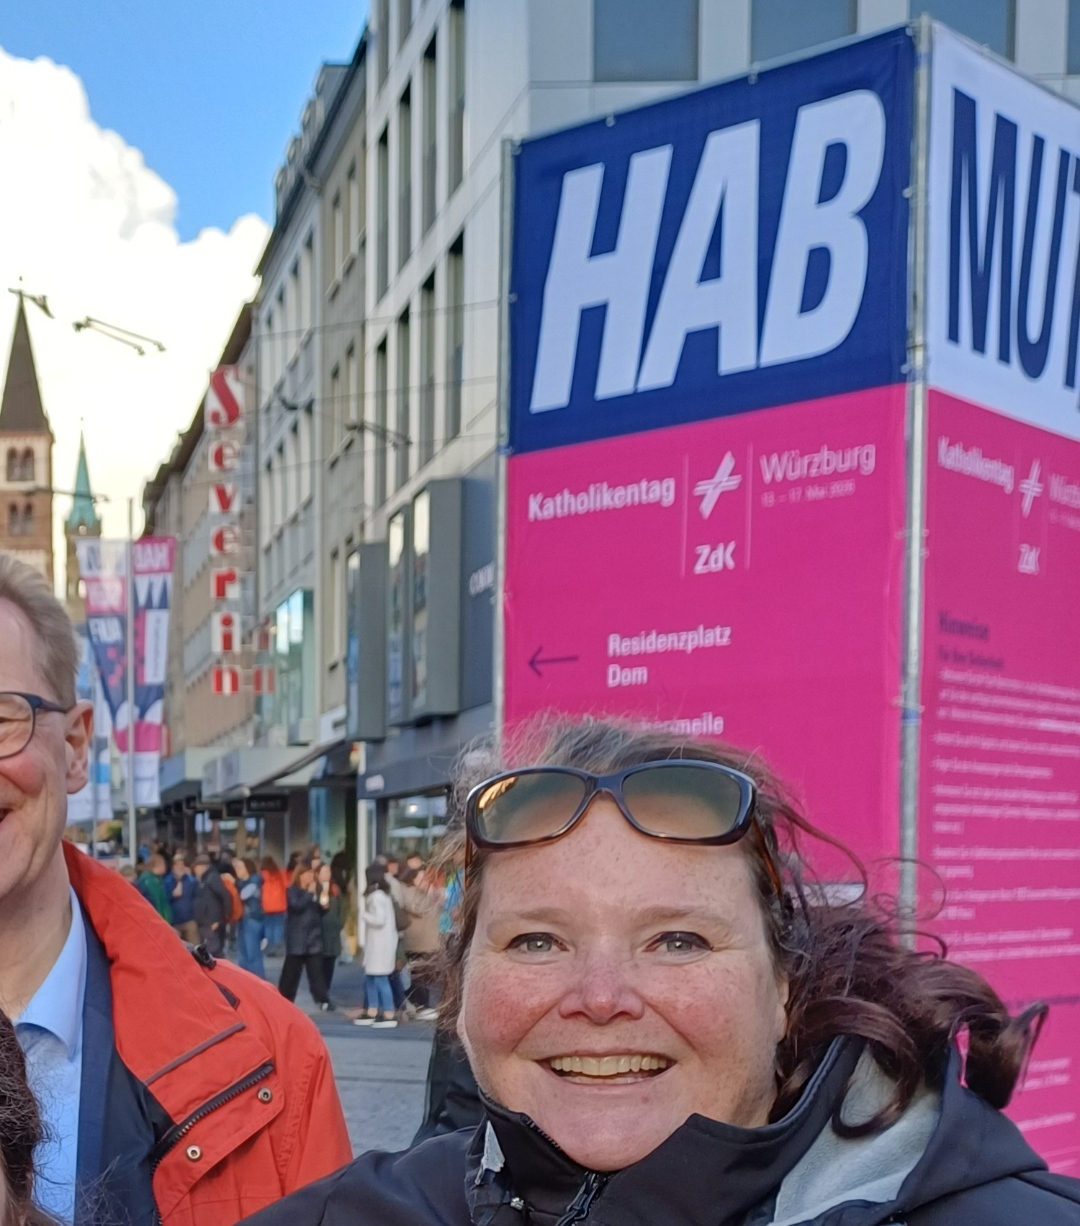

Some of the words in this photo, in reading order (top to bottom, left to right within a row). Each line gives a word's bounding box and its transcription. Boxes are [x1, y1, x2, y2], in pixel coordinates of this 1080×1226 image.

[530, 89, 886, 414] HAB
[761, 444, 875, 484] Würzburg
[528, 477, 675, 521] Katholikentag
[694, 541, 735, 574] ZdK
[607, 624, 732, 657] Residenzplatz
[607, 663, 648, 688] Dom
